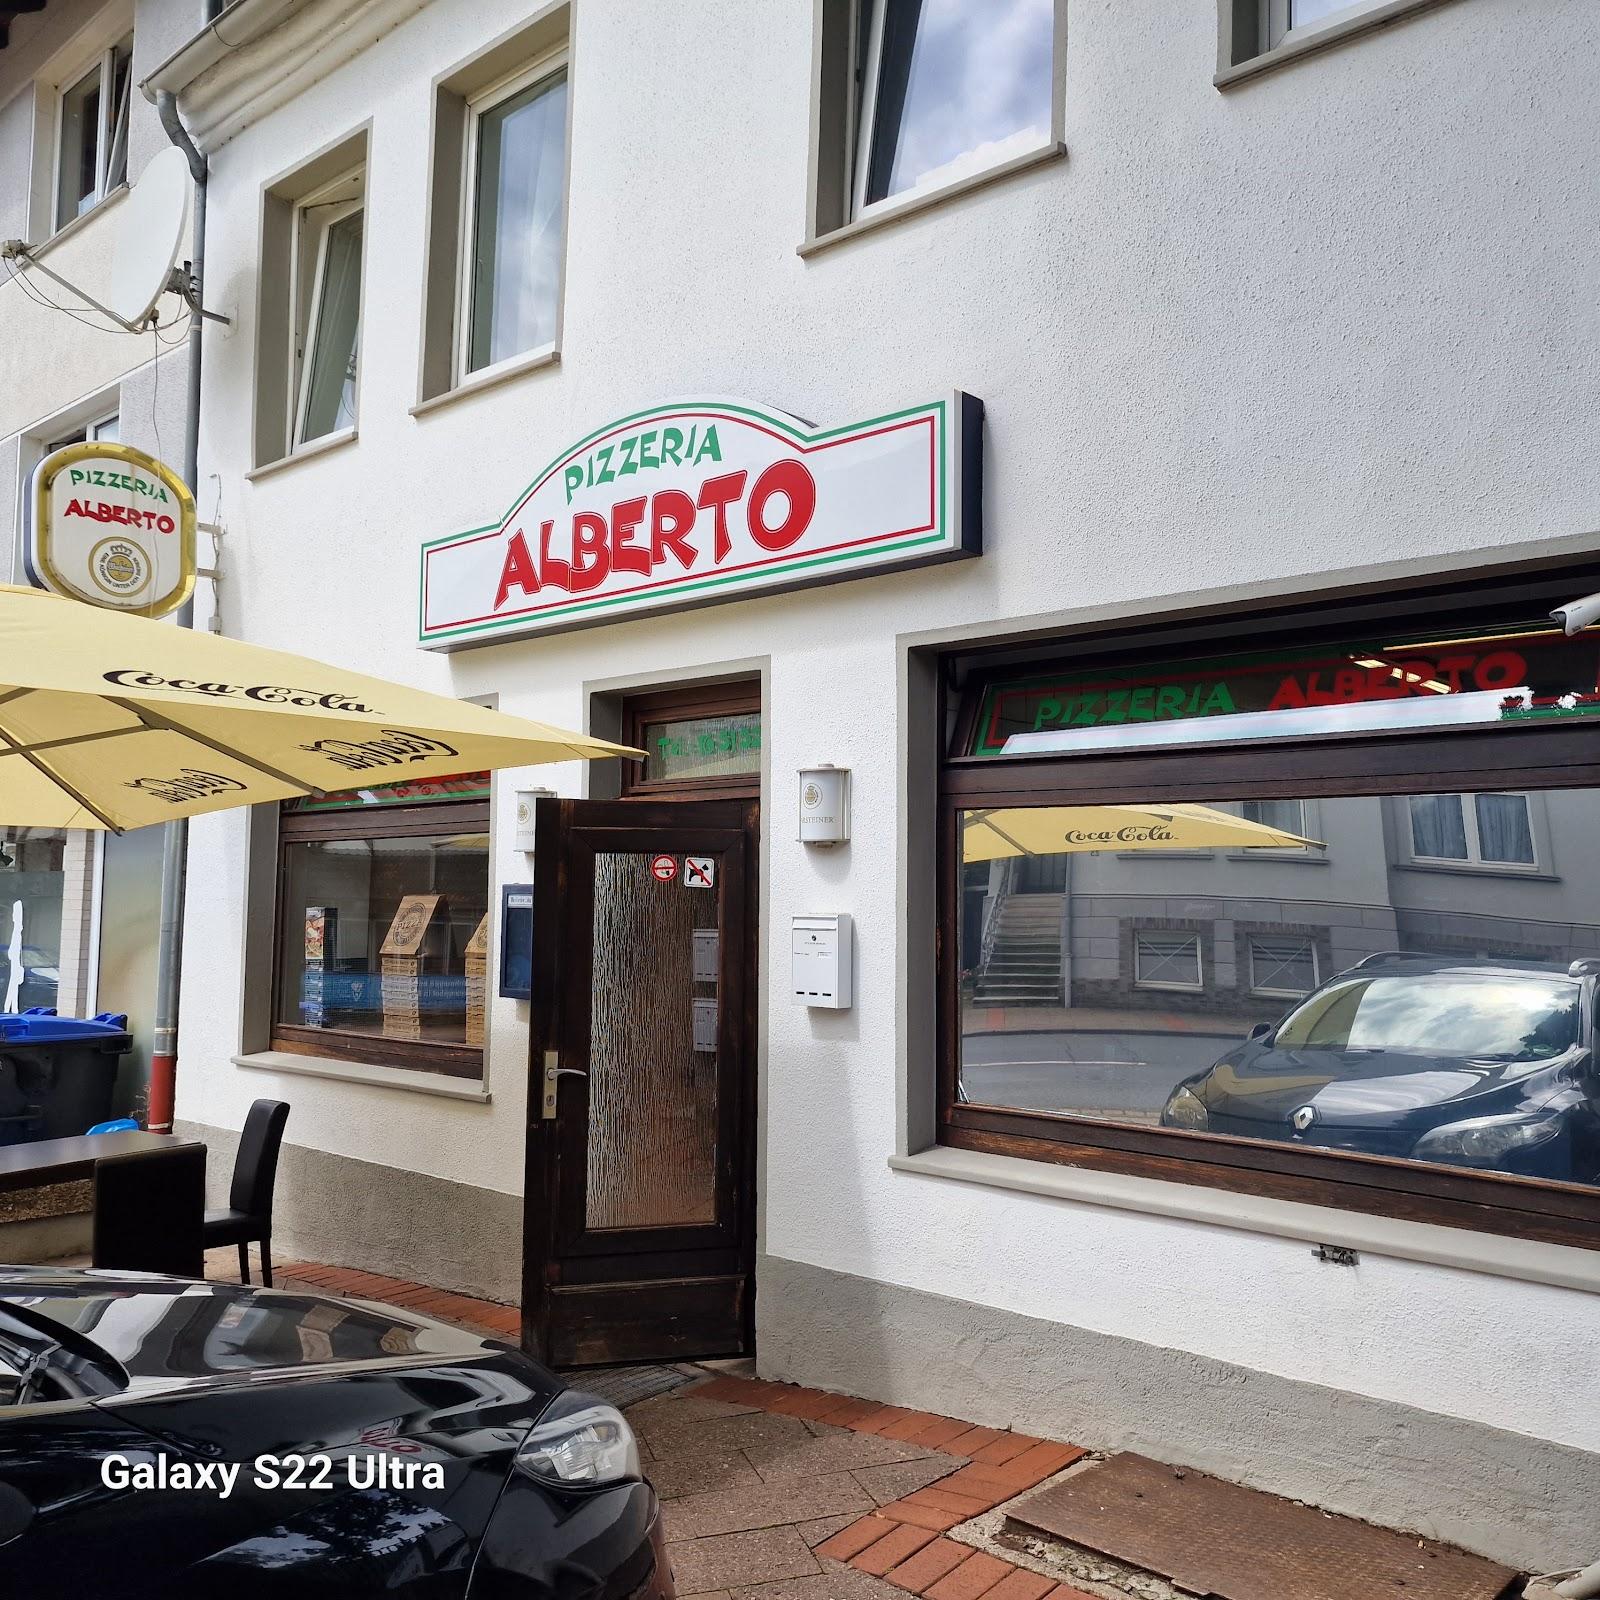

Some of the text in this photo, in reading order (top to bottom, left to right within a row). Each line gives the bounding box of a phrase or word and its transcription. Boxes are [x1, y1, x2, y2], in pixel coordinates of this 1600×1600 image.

[69, 469, 169, 504] PIZZERIA
[566, 424, 723, 505] PIZZERIA
[63, 498, 175, 534] ALBERTO
[493, 458, 816, 612] ALBERTO
[102, 669, 386, 715] Coca-Cola
[1267, 651, 1528, 711] ALBERTO
[1033, 681, 1236, 732] PIZZERIA
[1064, 825, 1178, 845] Coca-Cola
